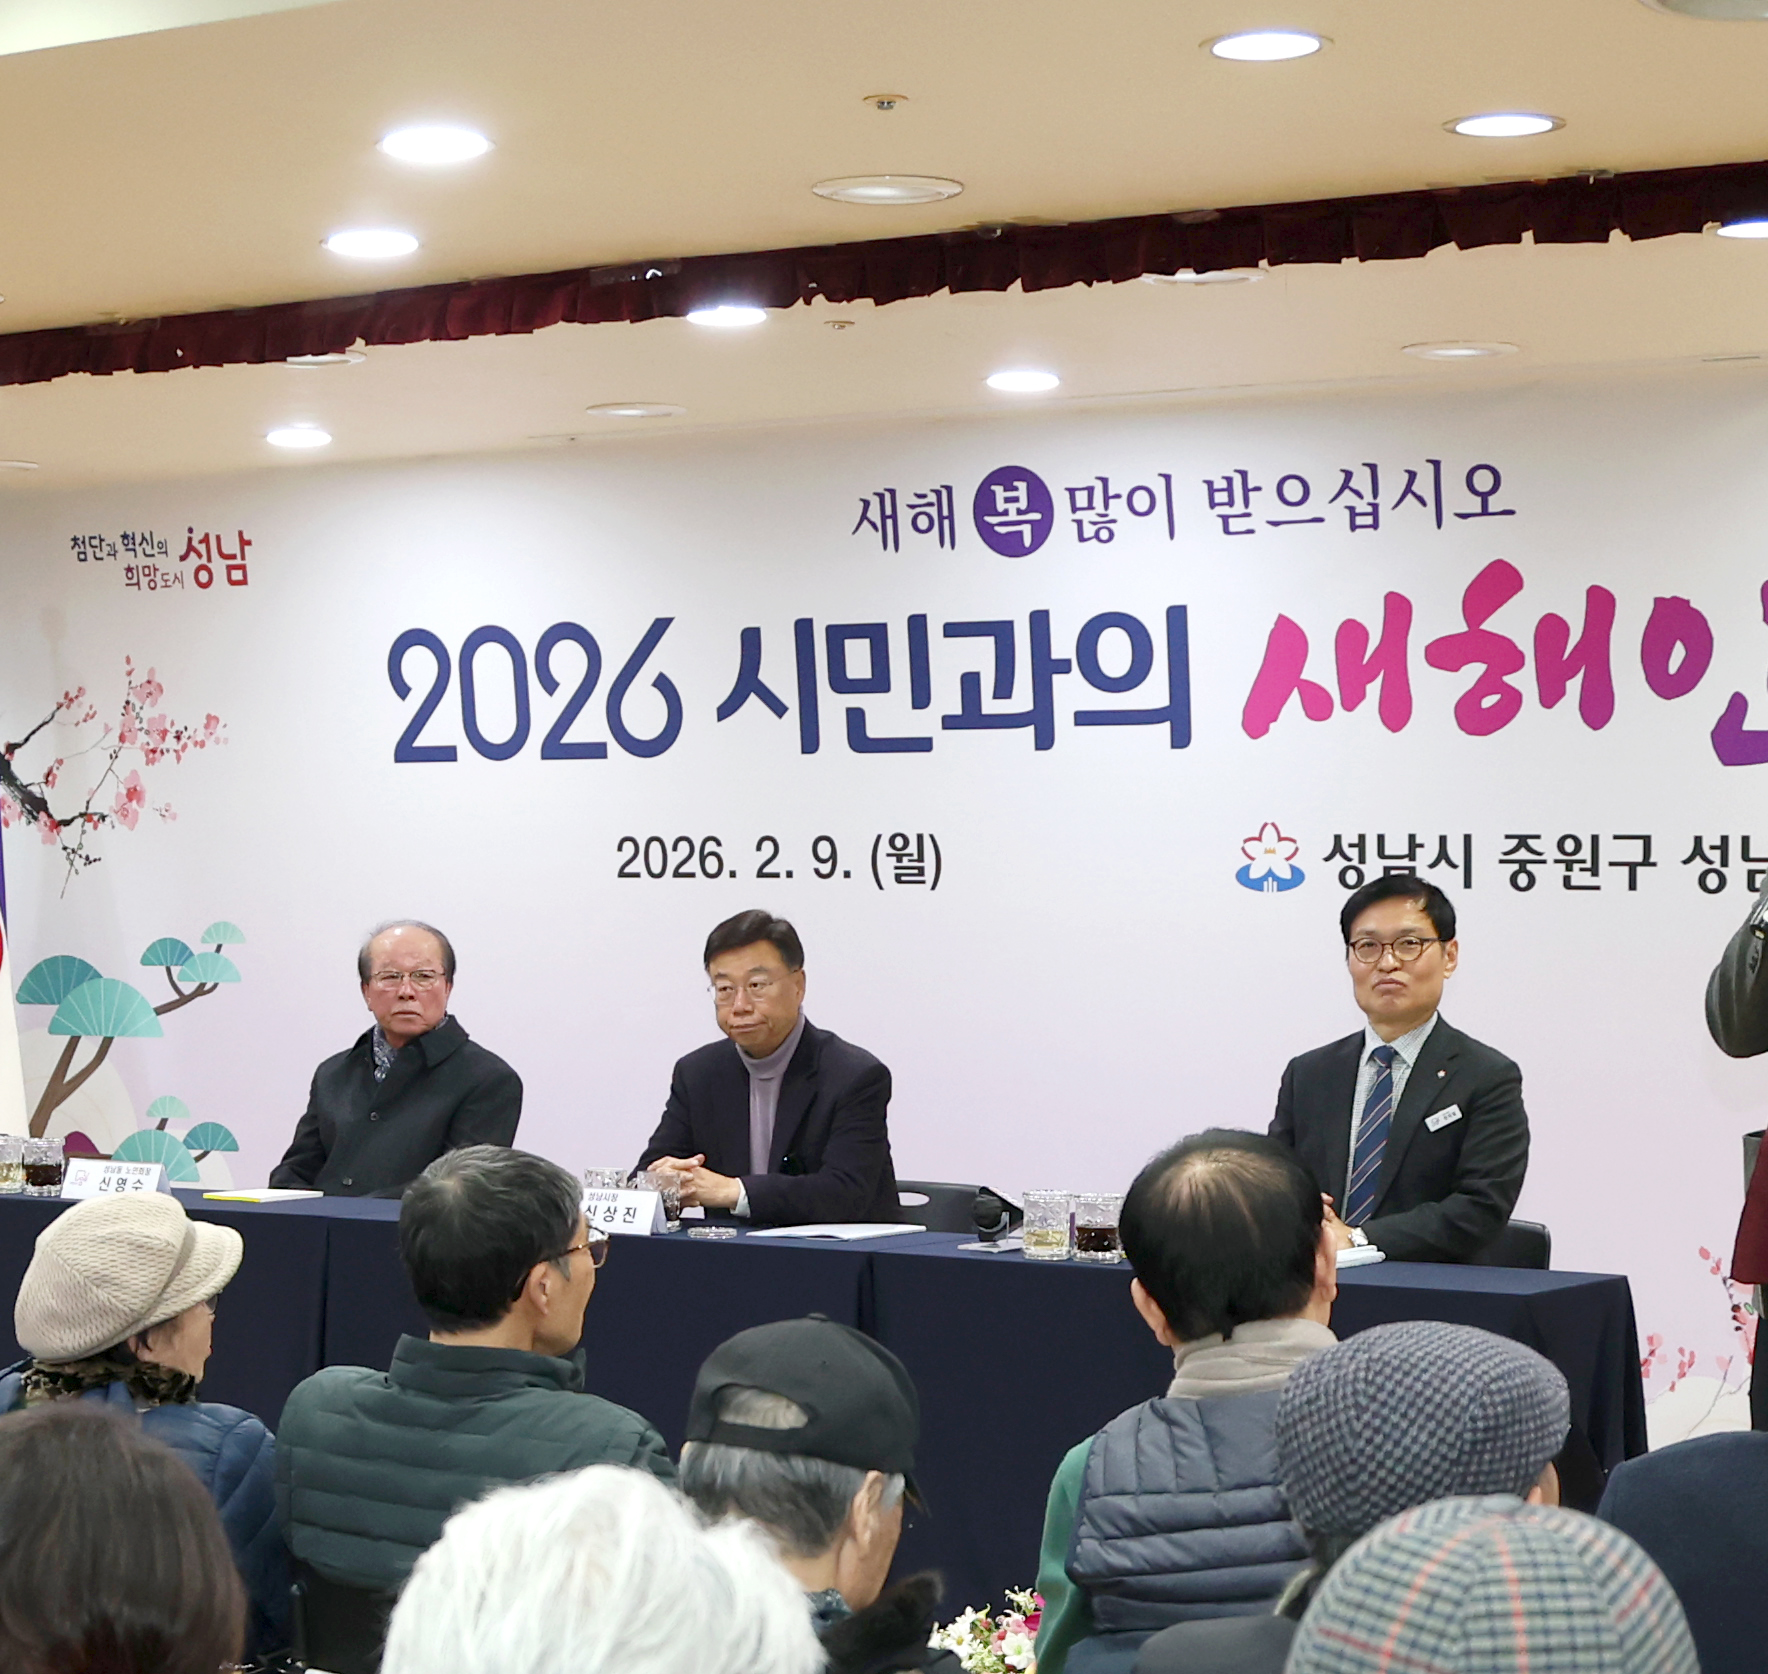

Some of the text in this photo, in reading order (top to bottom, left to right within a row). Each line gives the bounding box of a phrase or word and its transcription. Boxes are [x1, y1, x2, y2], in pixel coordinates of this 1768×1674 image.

[852, 459, 1517, 553] 새해 복 많이 받으십시오
[70, 530, 168, 562] 첨단과 혁신의
[123, 558, 187, 591] 희망도시
[177, 526, 253, 590] 성남
[387, 616, 684, 764] 2026
[716, 604, 1192, 755] 시민과의
[617, 831, 942, 892] 2026. 2. 9. (월)
[1322, 833, 1473, 891] 성남시
[1498, 834, 1658, 892] 중원구
[98, 1176, 144, 1193] 신영수
